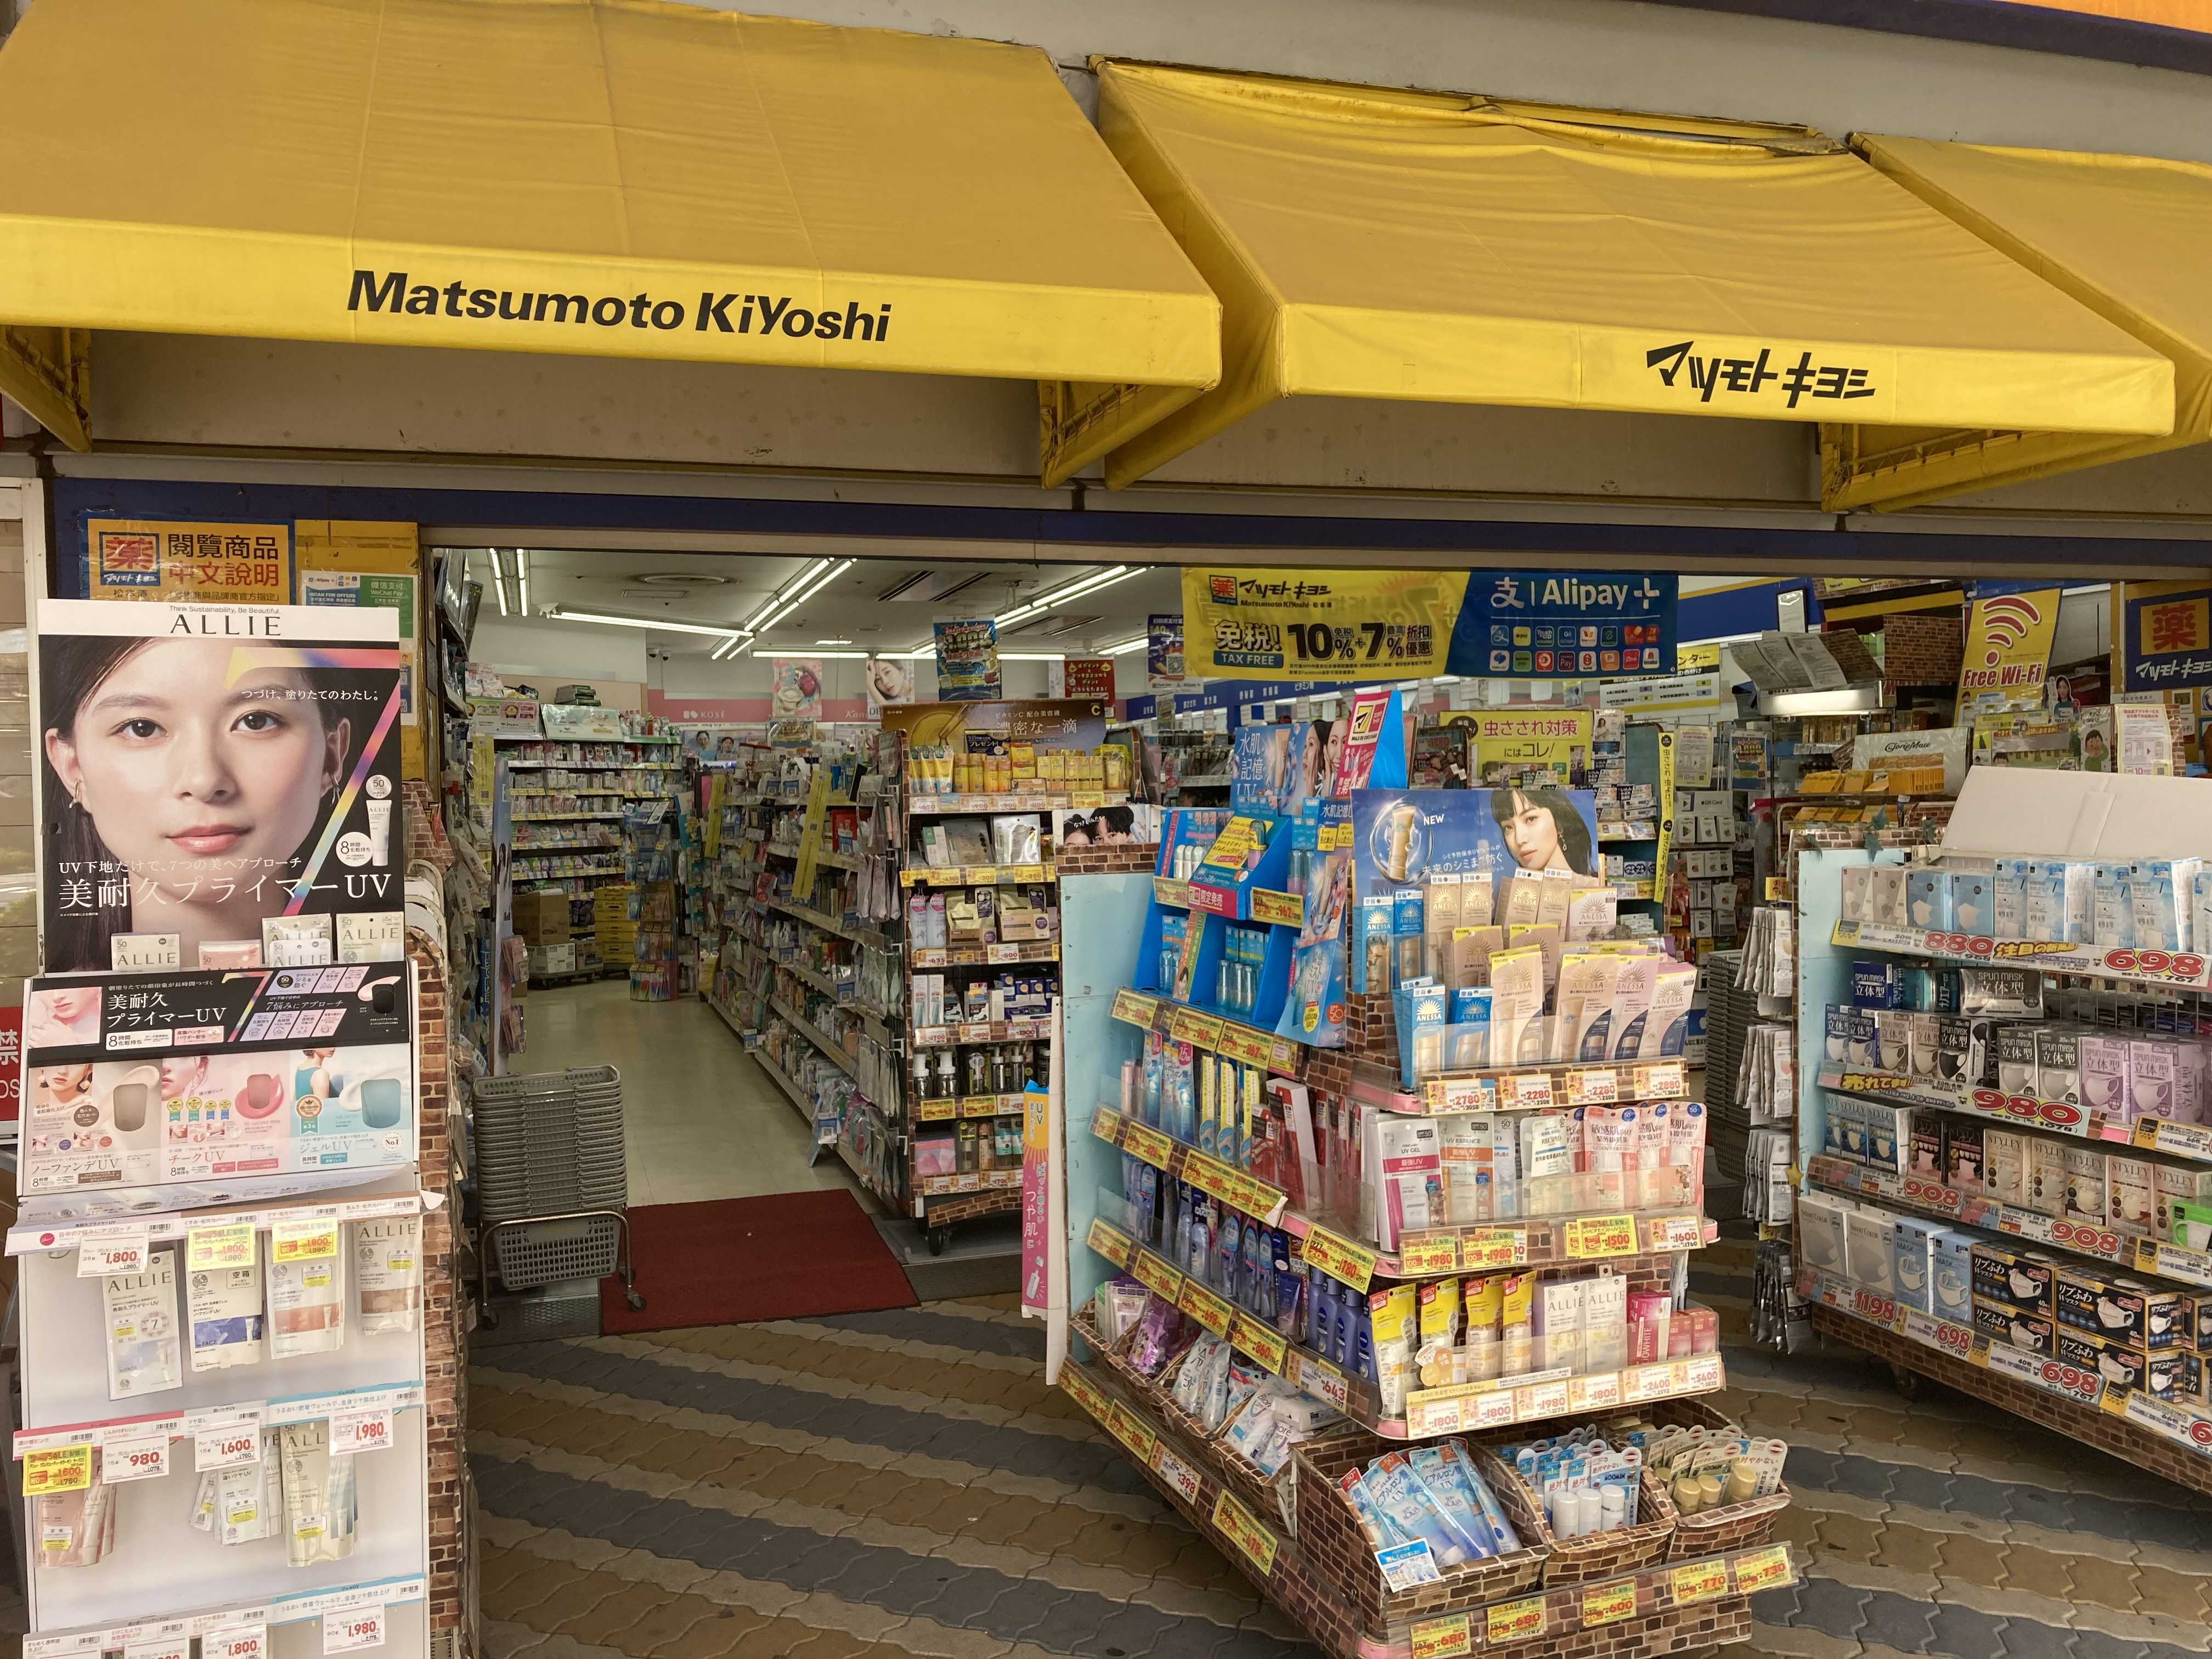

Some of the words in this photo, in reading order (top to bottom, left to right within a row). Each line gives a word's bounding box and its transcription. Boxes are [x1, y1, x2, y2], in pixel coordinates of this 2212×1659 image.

[347, 270, 685, 330] Matsumoto
[695, 292, 891, 341] KiYoshi
[1646, 341, 1876, 408] マツモトキヨシ
[105, 536, 154, 571] 薬
[1212, 578, 1234, 596] 薬
[1239, 579, 1331, 599] マツモトキヨシ
[189, 606, 236, 614] Sustainability,
[170, 614, 281, 635] ALLIE
[2152, 602, 2198, 652] 薬
[1221, 653, 1244, 664] TAX
[1247, 654, 1274, 665] FREE
[1962, 667, 1997, 689] Free
[2000, 662, 2044, 687] Wi-Fi
[1483, 719, 1578, 737] 虫さされ対策
[1237, 732, 1261, 756] 水肌
[1884, 741, 1931, 753] CalorieMate
[1240, 757, 1263, 781] 記憶
[1423, 814, 1444, 826] NEW
[341, 840, 349, 854] 8
[59, 873, 392, 911] 美耐久プライマーUV
[1513, 896, 1537, 906] ANESSA
[342, 927, 399, 940] ALLIE
[1923, 930, 1995, 956] 880
[117, 952, 177, 966] ALLIE
[2104, 947, 2204, 978] 698
[108, 990, 168, 1011] 美耐久
[1656, 996, 1683, 1005] ANESSA
[107, 1007, 227, 1029] プライマーUV
[1416, 1014, 1442, 1022] ANESSA
[108, 1035, 118, 1047] 8
[1941, 1034, 1968, 1046] 立体型
[2000, 1037, 2015, 1046] SPUN
[2041, 1042, 2056, 1051] SPUN
[2057, 1043, 2075, 1052] MASK
[2001, 1046, 2033, 1060] 立体型
[2041, 1052, 2075, 1066] 立体型
[2085, 1049, 2100, 1058] SPUN
[2101, 1049, 2120, 1059] MASK
[2134, 1053, 2149, 1062] SPUN
[2149, 1054, 2168, 1064] MASK
[2085, 1058, 2120, 1072] 立体型
[2134, 1063, 2169, 1076] 立体型
[1592, 1086, 1615, 1096] 2280
[1657, 1081, 1681, 1091] 2880
[1455, 1095, 1480, 1105] 2780
[1526, 1089, 1550, 1100] 2280
[1972, 1088, 2083, 1126] 980
[1988, 1134, 2022, 1149] STYLEY
[2112, 1161, 2148, 1178] STYLEY
[1904, 1178, 1962, 1207] 908
[359, 1223, 417, 1239] ALLIE
[1674, 1232, 1698, 1243] 1600
[2051, 1220, 2121, 1255] 908
[307, 1238, 329, 1247] 1,800
[1607, 1234, 1630, 1246] 1500
[1897, 1242, 1914, 1252] MASK
[1429, 1254, 1453, 1266] 1980
[1489, 1249, 1511, 1261] 1980
[1338, 1258, 1357, 1278] 1780
[1936, 1257, 1954, 1268] MASK
[108, 1271, 172, 1294] ALLIE
[2058, 1283, 2093, 1304] リブふわ
[1855, 1289, 1896, 1322] 1198
[1936, 1323, 1972, 1352] 698
[2061, 1339, 2094, 1359] リブふわ
[1695, 1371, 1718, 1383] 5400
[2040, 1361, 2101, 1396] 698
[1324, 1380, 1345, 1401] 643
[1648, 1379, 1671, 1391] 2400
[1593, 1387, 1617, 1400] 1800
[1541, 1397, 1566, 1409] 1980
[1486, 1406, 1512, 1418] 1800
[1432, 1415, 1459, 1427] 1800
[355, 1421, 385, 1441] 1,980
[129, 1452, 160, 1466] 980
[1179, 1474, 1196, 1494] 398
[1604, 1473, 1625, 1481] MOOMIN
[1762, 1562, 1786, 1578] 730
[1701, 1575, 1726, 1589] 770
[1608, 1600, 1633, 1612] 600
[1514, 1613, 1541, 1627] 680
[348, 1621, 376, 1637] 1,980
[228, 1639, 257, 1656] 1,800
